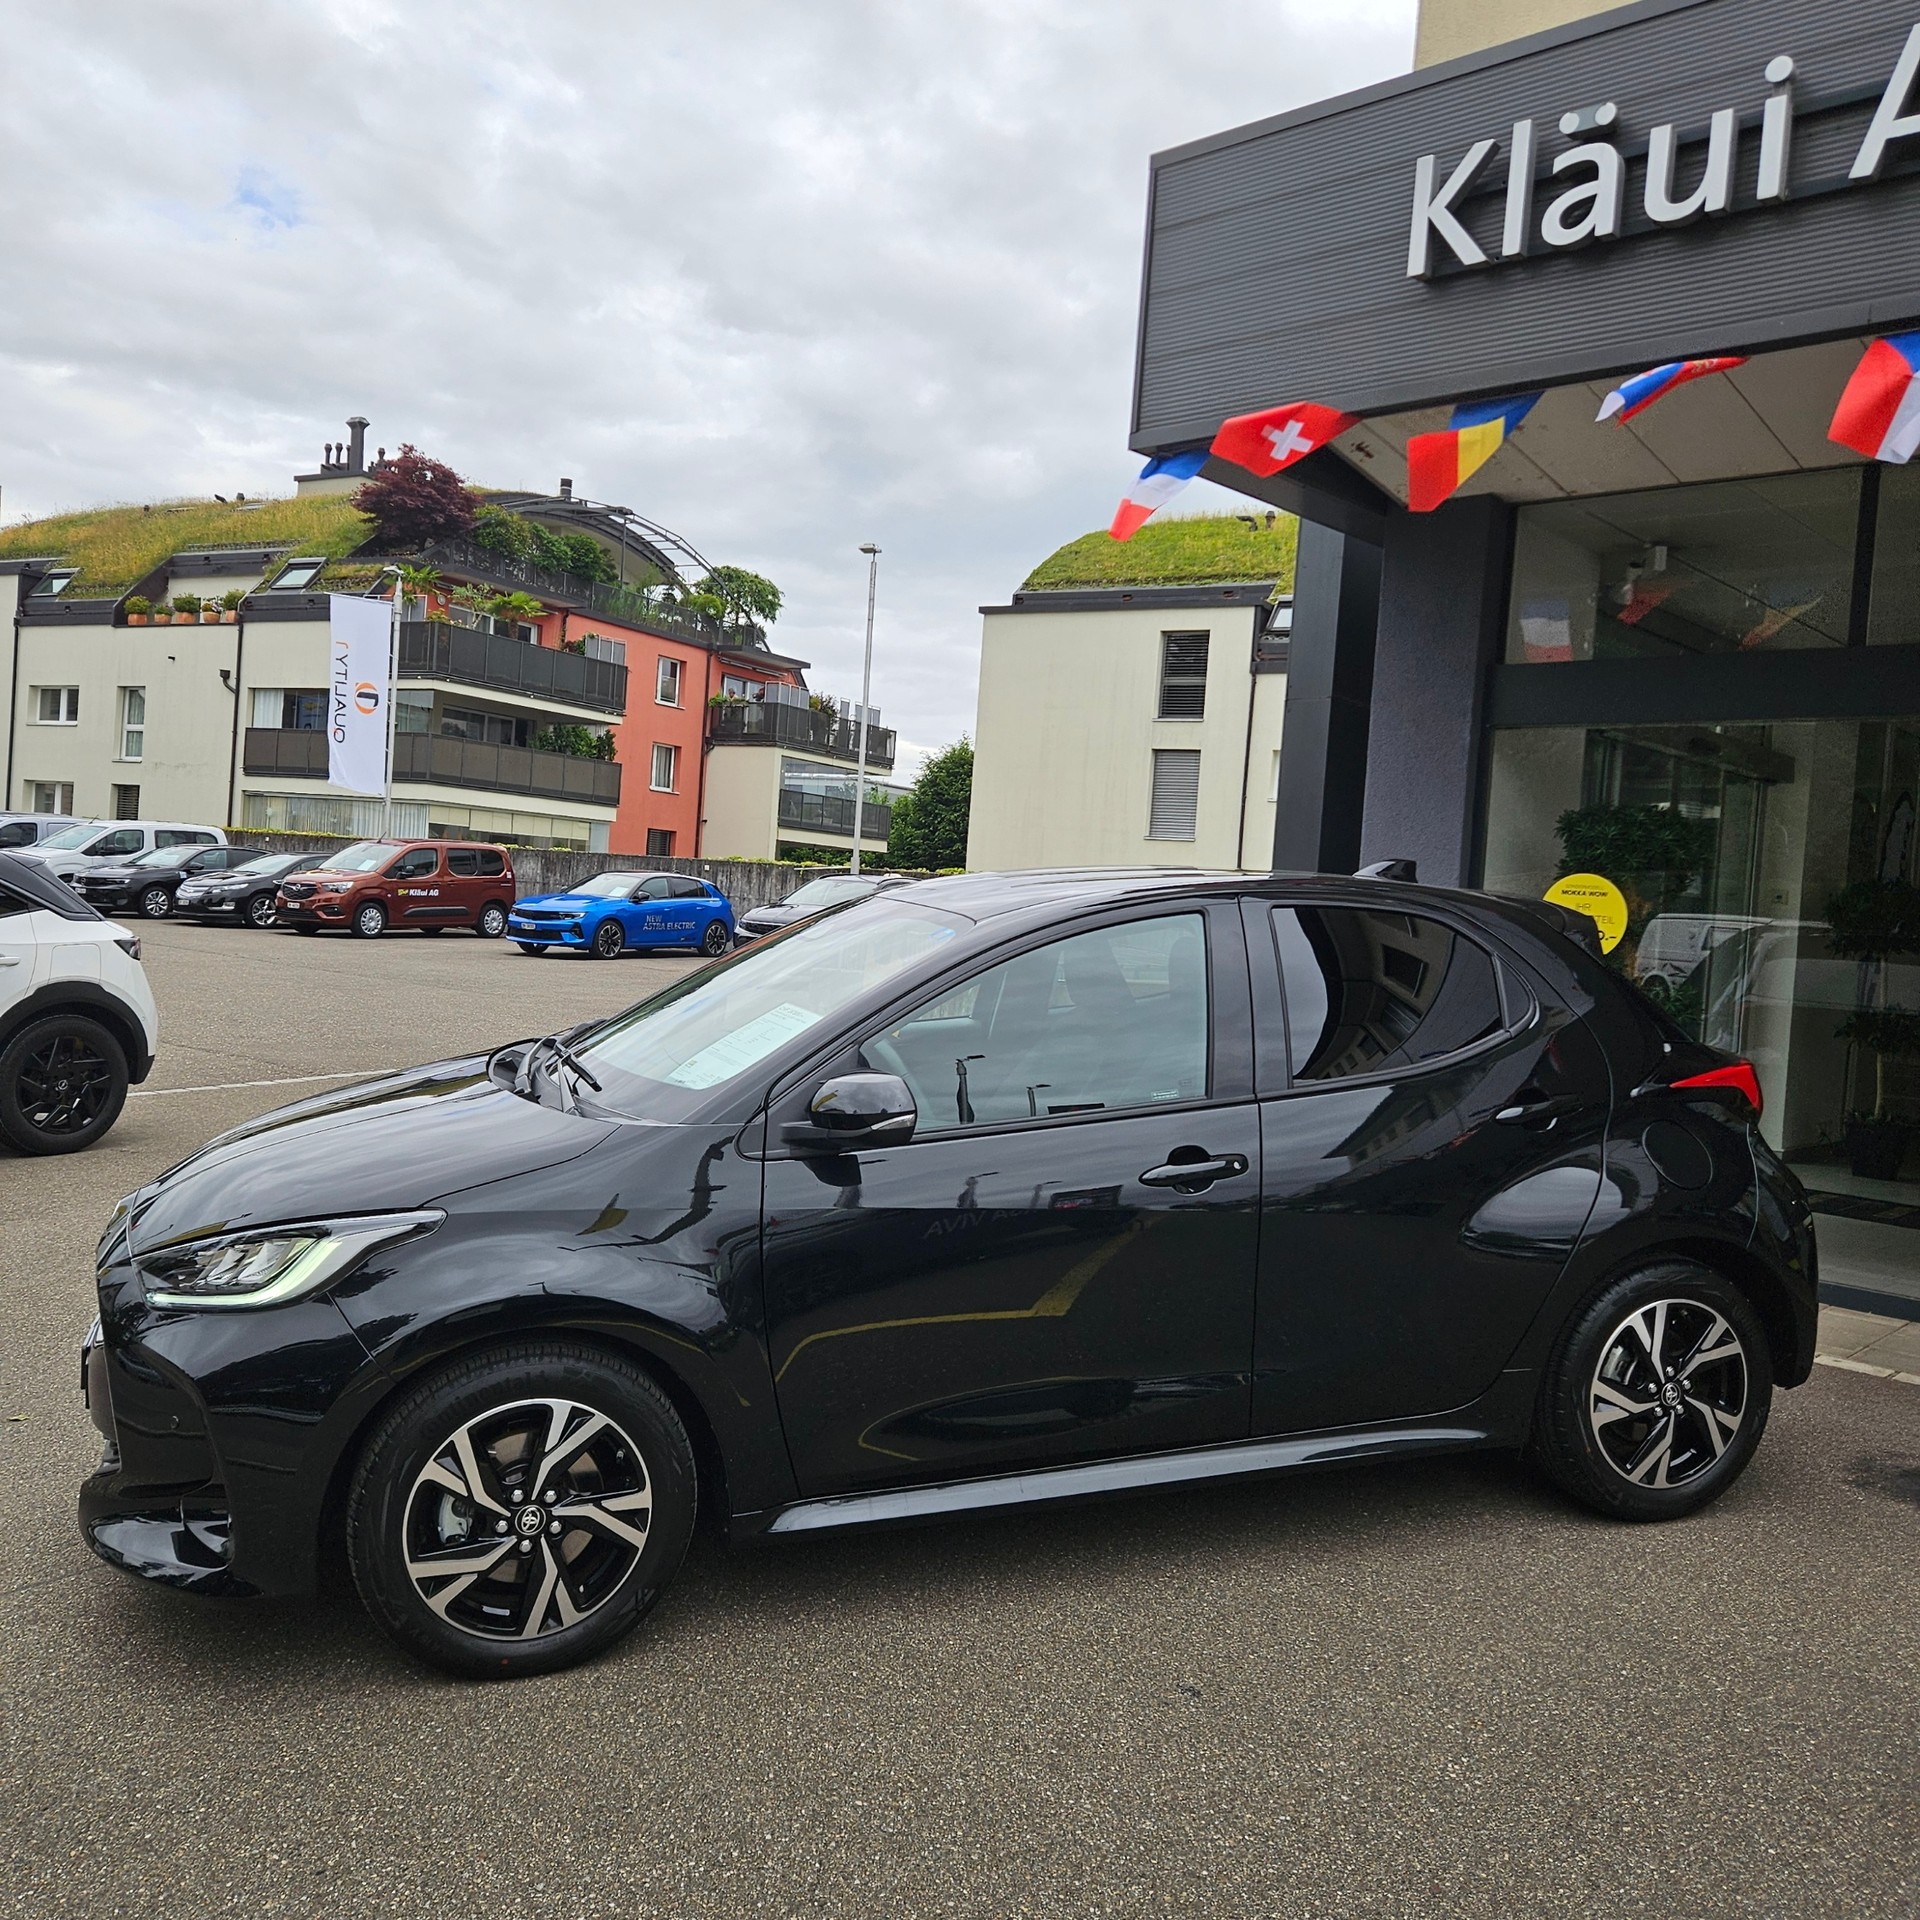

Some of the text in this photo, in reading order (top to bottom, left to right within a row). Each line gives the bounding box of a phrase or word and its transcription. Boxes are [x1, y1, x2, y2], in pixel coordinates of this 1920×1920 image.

[1407, 55, 1796, 280] Kläui
[646, 914, 662, 923] NEW
[1594, 914, 1616, 925] TEIL
[643, 921, 696, 931] ASTRA ELECTRIC
